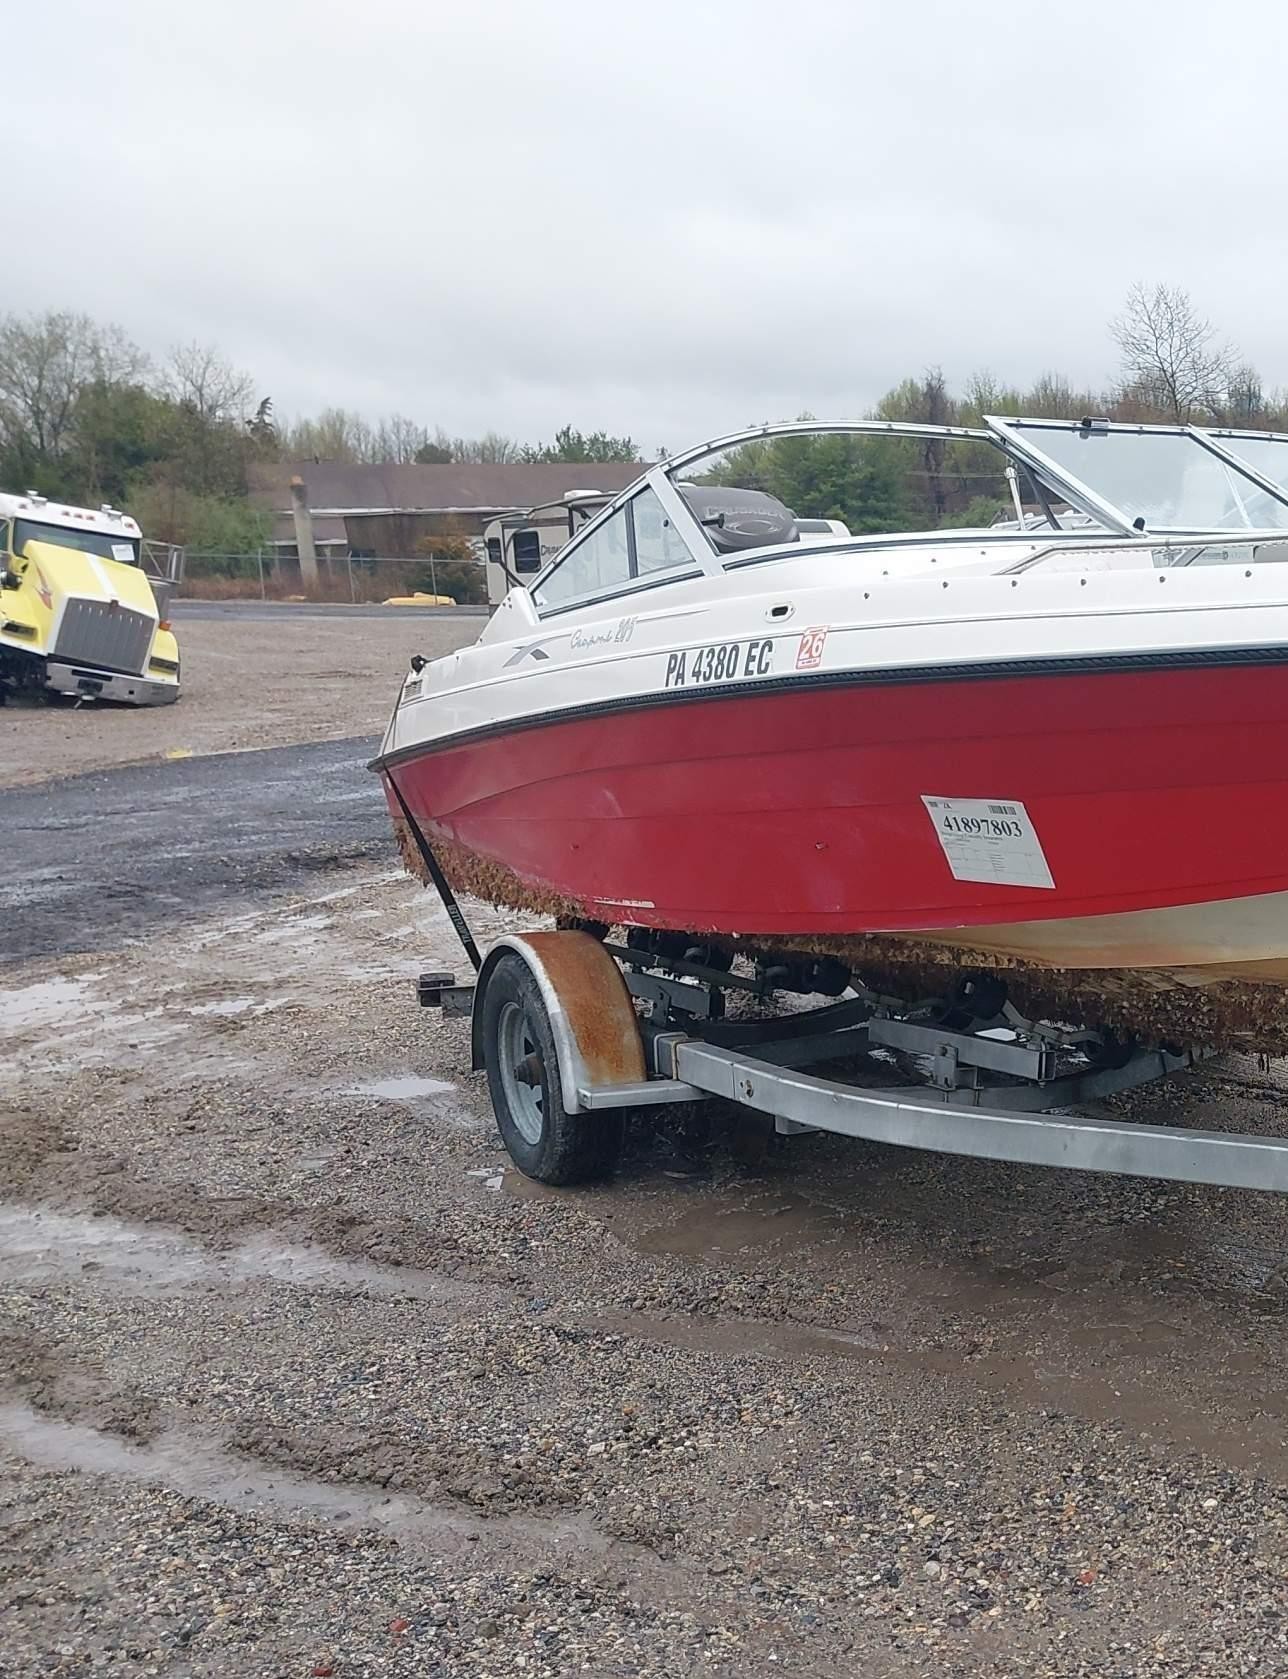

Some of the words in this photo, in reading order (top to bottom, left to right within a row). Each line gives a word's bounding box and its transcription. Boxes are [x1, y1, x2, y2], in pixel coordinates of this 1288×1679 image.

[799, 632, 825, 659] 26
[665, 652, 687, 687] PA
[691, 645, 740, 683] 4380
[744, 640, 774, 677] EC
[943, 815, 1023, 838] 41897803
